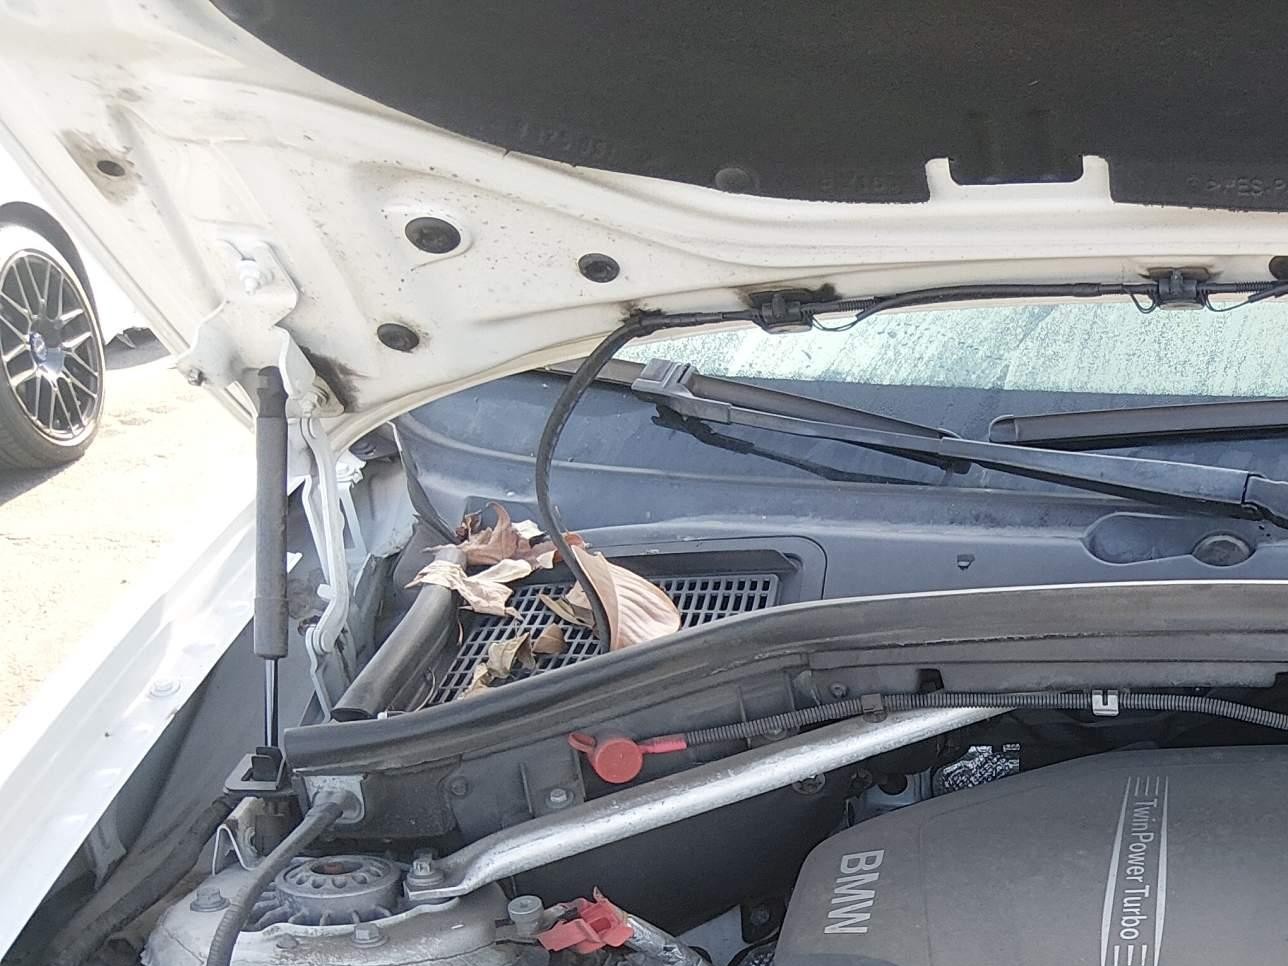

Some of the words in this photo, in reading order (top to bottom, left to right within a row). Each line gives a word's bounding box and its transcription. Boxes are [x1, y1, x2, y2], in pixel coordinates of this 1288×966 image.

[1125, 798, 1158, 883] TwinPower
[823, 849, 885, 934] BMW
[1119, 884, 1150, 940] Turbo
